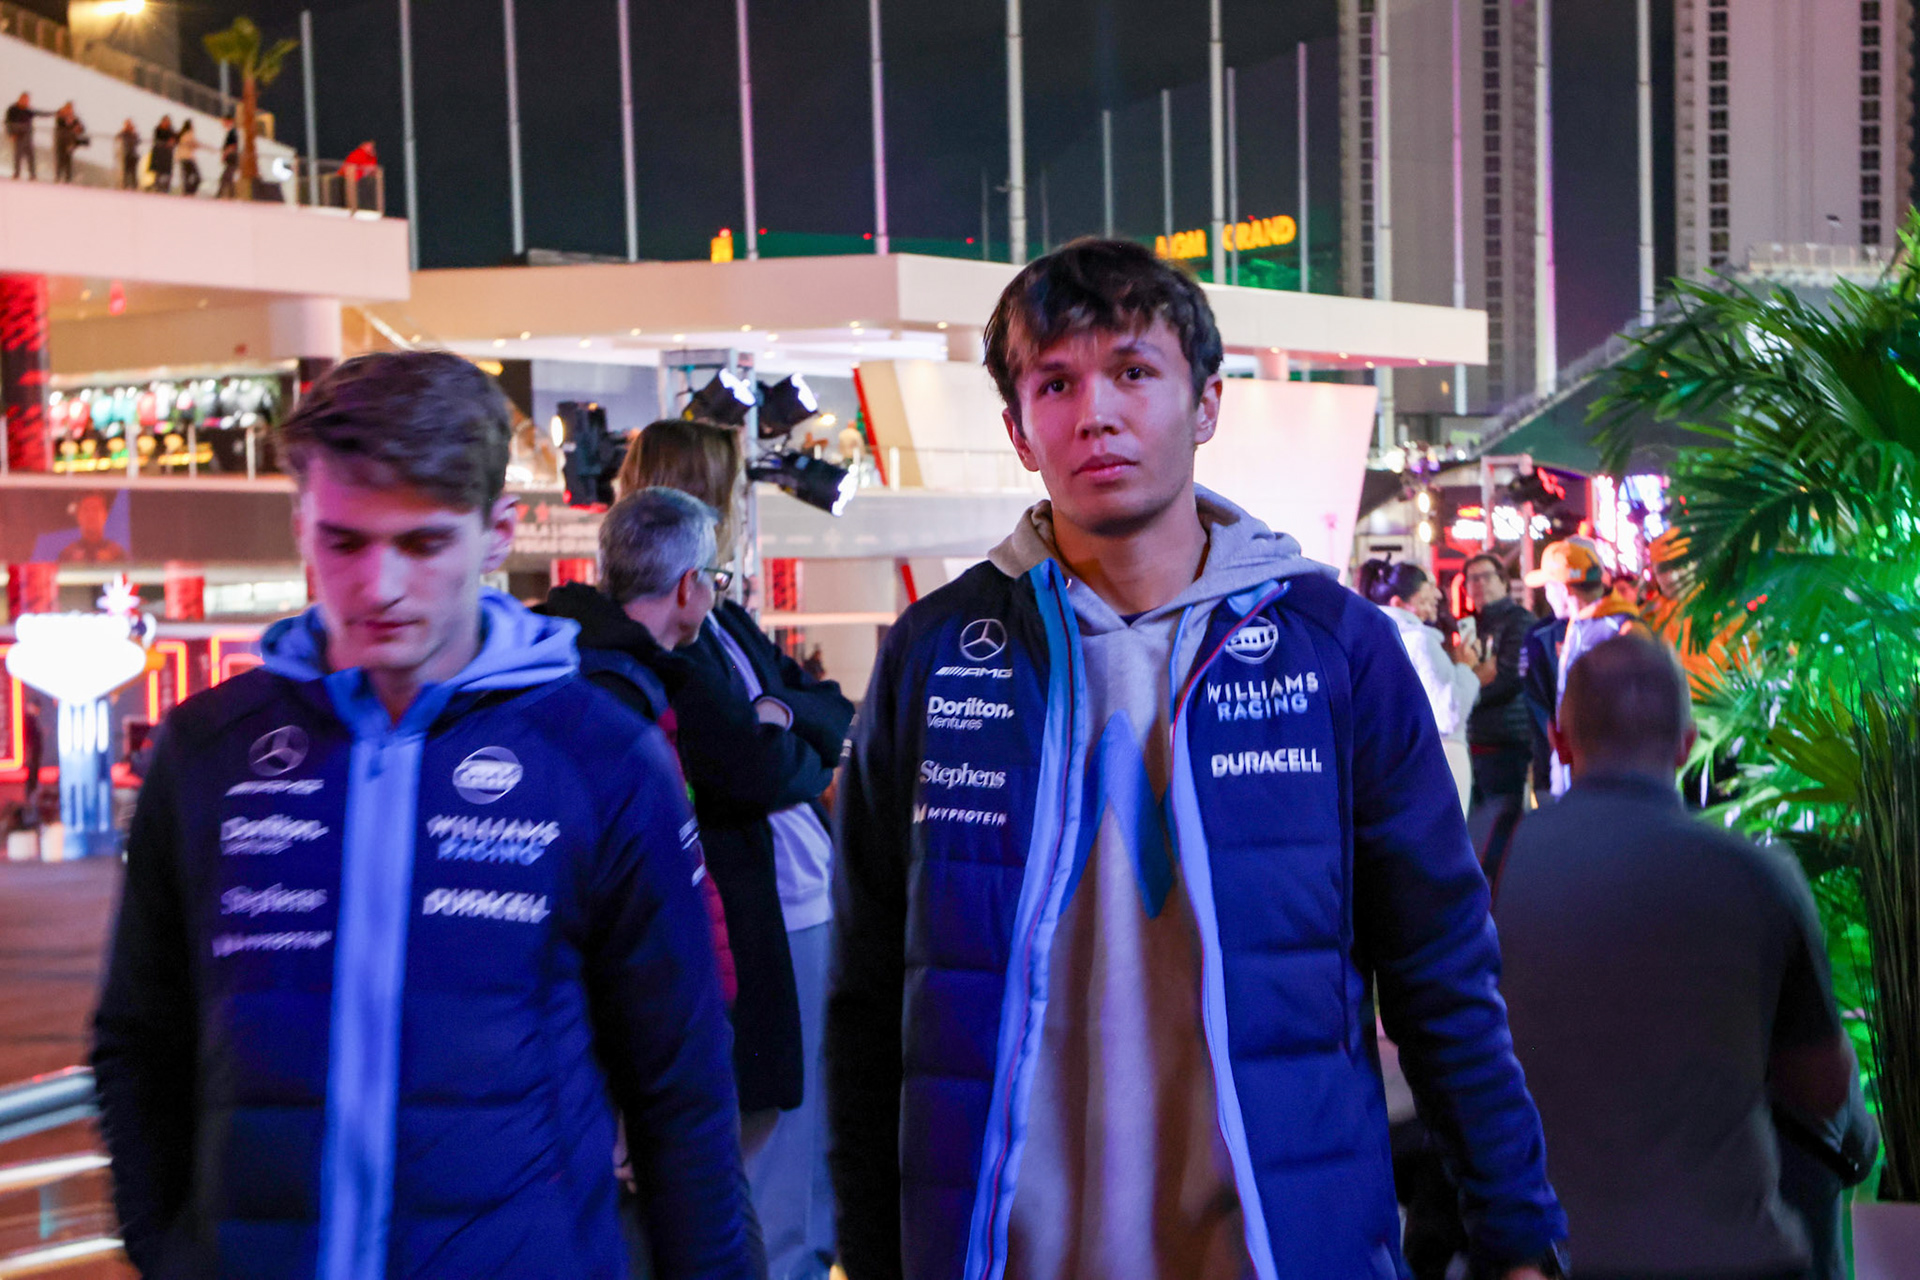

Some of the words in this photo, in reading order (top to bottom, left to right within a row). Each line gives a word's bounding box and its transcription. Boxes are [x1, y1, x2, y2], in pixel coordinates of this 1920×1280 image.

[1221, 214, 1297, 251] GRAND
[961, 667, 1013, 679] AMG
[1207, 671, 1319, 704] WILLIAMS
[927, 714, 983, 730] Ventures
[1217, 693, 1308, 722] RACING
[920, 760, 1006, 790] Stephens
[1211, 748, 1322, 778] DURACELL
[927, 807, 1007, 826] MYPROTEIN
